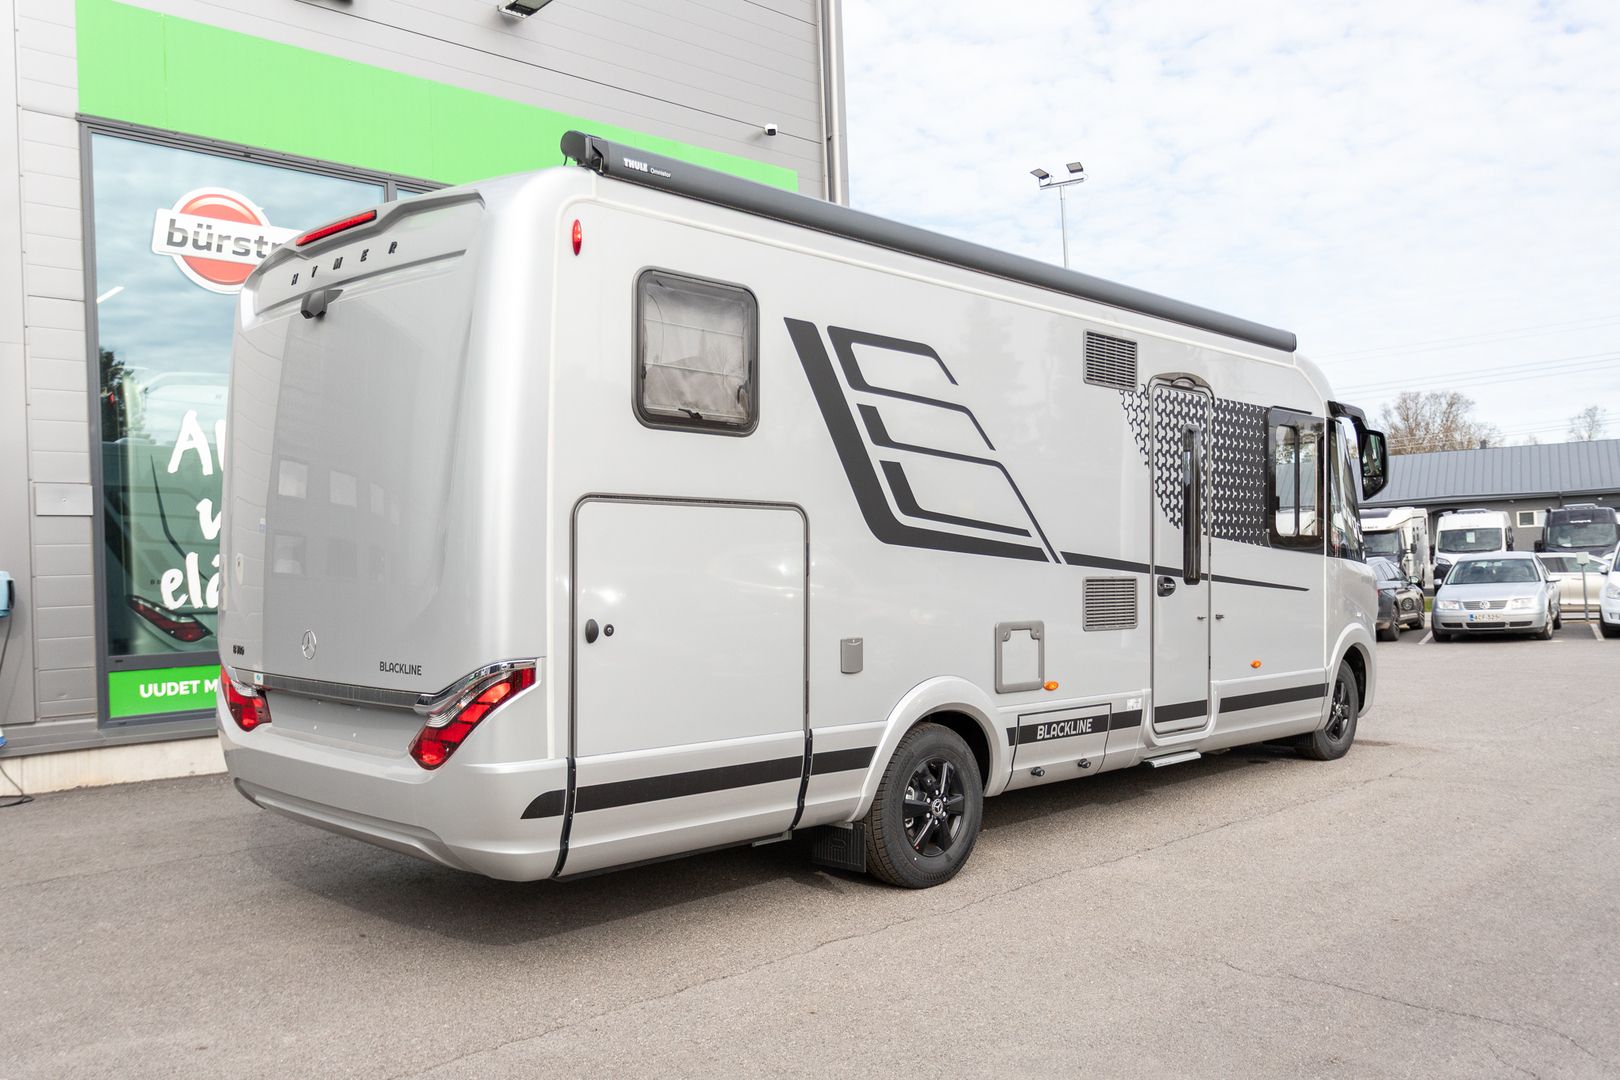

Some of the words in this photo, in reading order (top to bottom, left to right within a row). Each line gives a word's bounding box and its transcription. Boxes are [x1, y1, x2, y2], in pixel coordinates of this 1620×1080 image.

[623, 157, 649, 173] THULE
[291, 241, 398, 286] HYMER
[379, 661, 422, 676] BLACKLINE
[139, 680, 201, 698] UUDET
[1036, 718, 1093, 740] BLACKLINE
